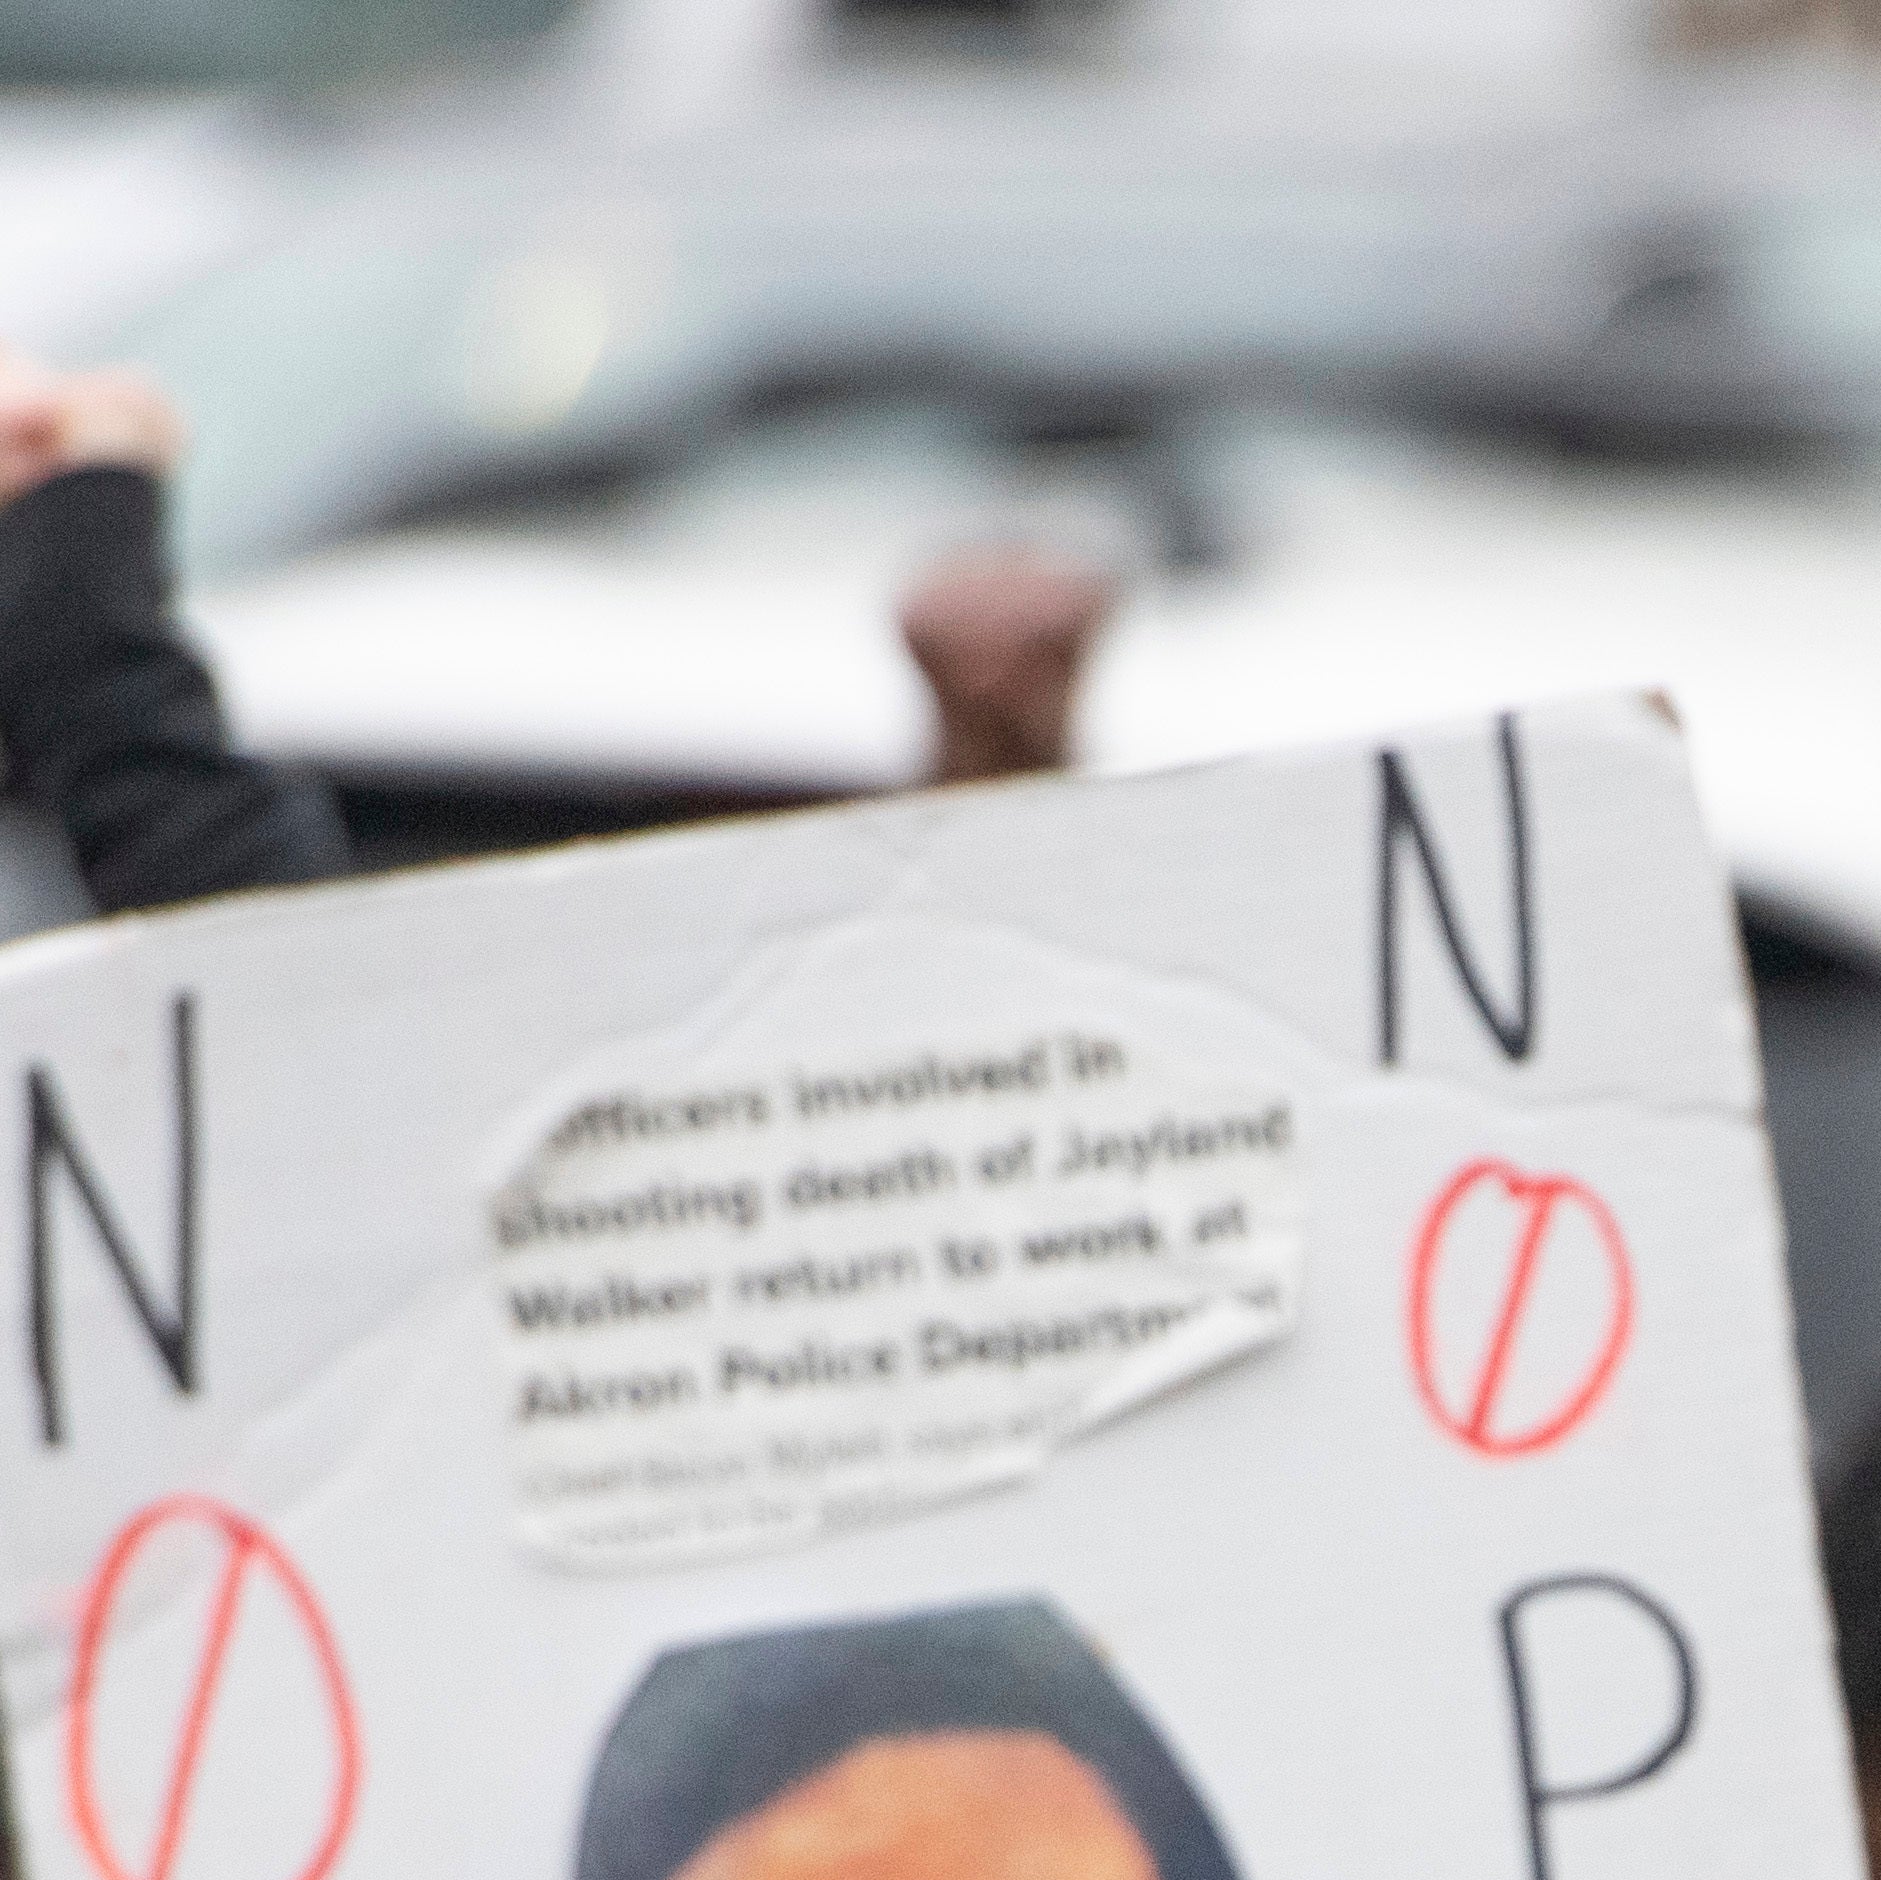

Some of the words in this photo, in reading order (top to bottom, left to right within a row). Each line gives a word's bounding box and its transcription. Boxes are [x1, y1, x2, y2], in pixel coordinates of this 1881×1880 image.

[796, 1038, 1050, 1117] involved
[1065, 1031, 1127, 1082] in
[784, 1147, 957, 1209] death
[979, 1131, 1036, 1184] of
[1058, 1102, 1294, 1180] Jayland
[510, 1267, 711, 1334] Walker
[737, 1242, 920, 1305] return
[940, 1235, 1000, 1279] to
[1023, 1208, 1165, 1269] work
[1195, 1198, 1250, 1245] at
[515, 1361, 697, 1425] Akron
[721, 1333, 899, 1395] Police
